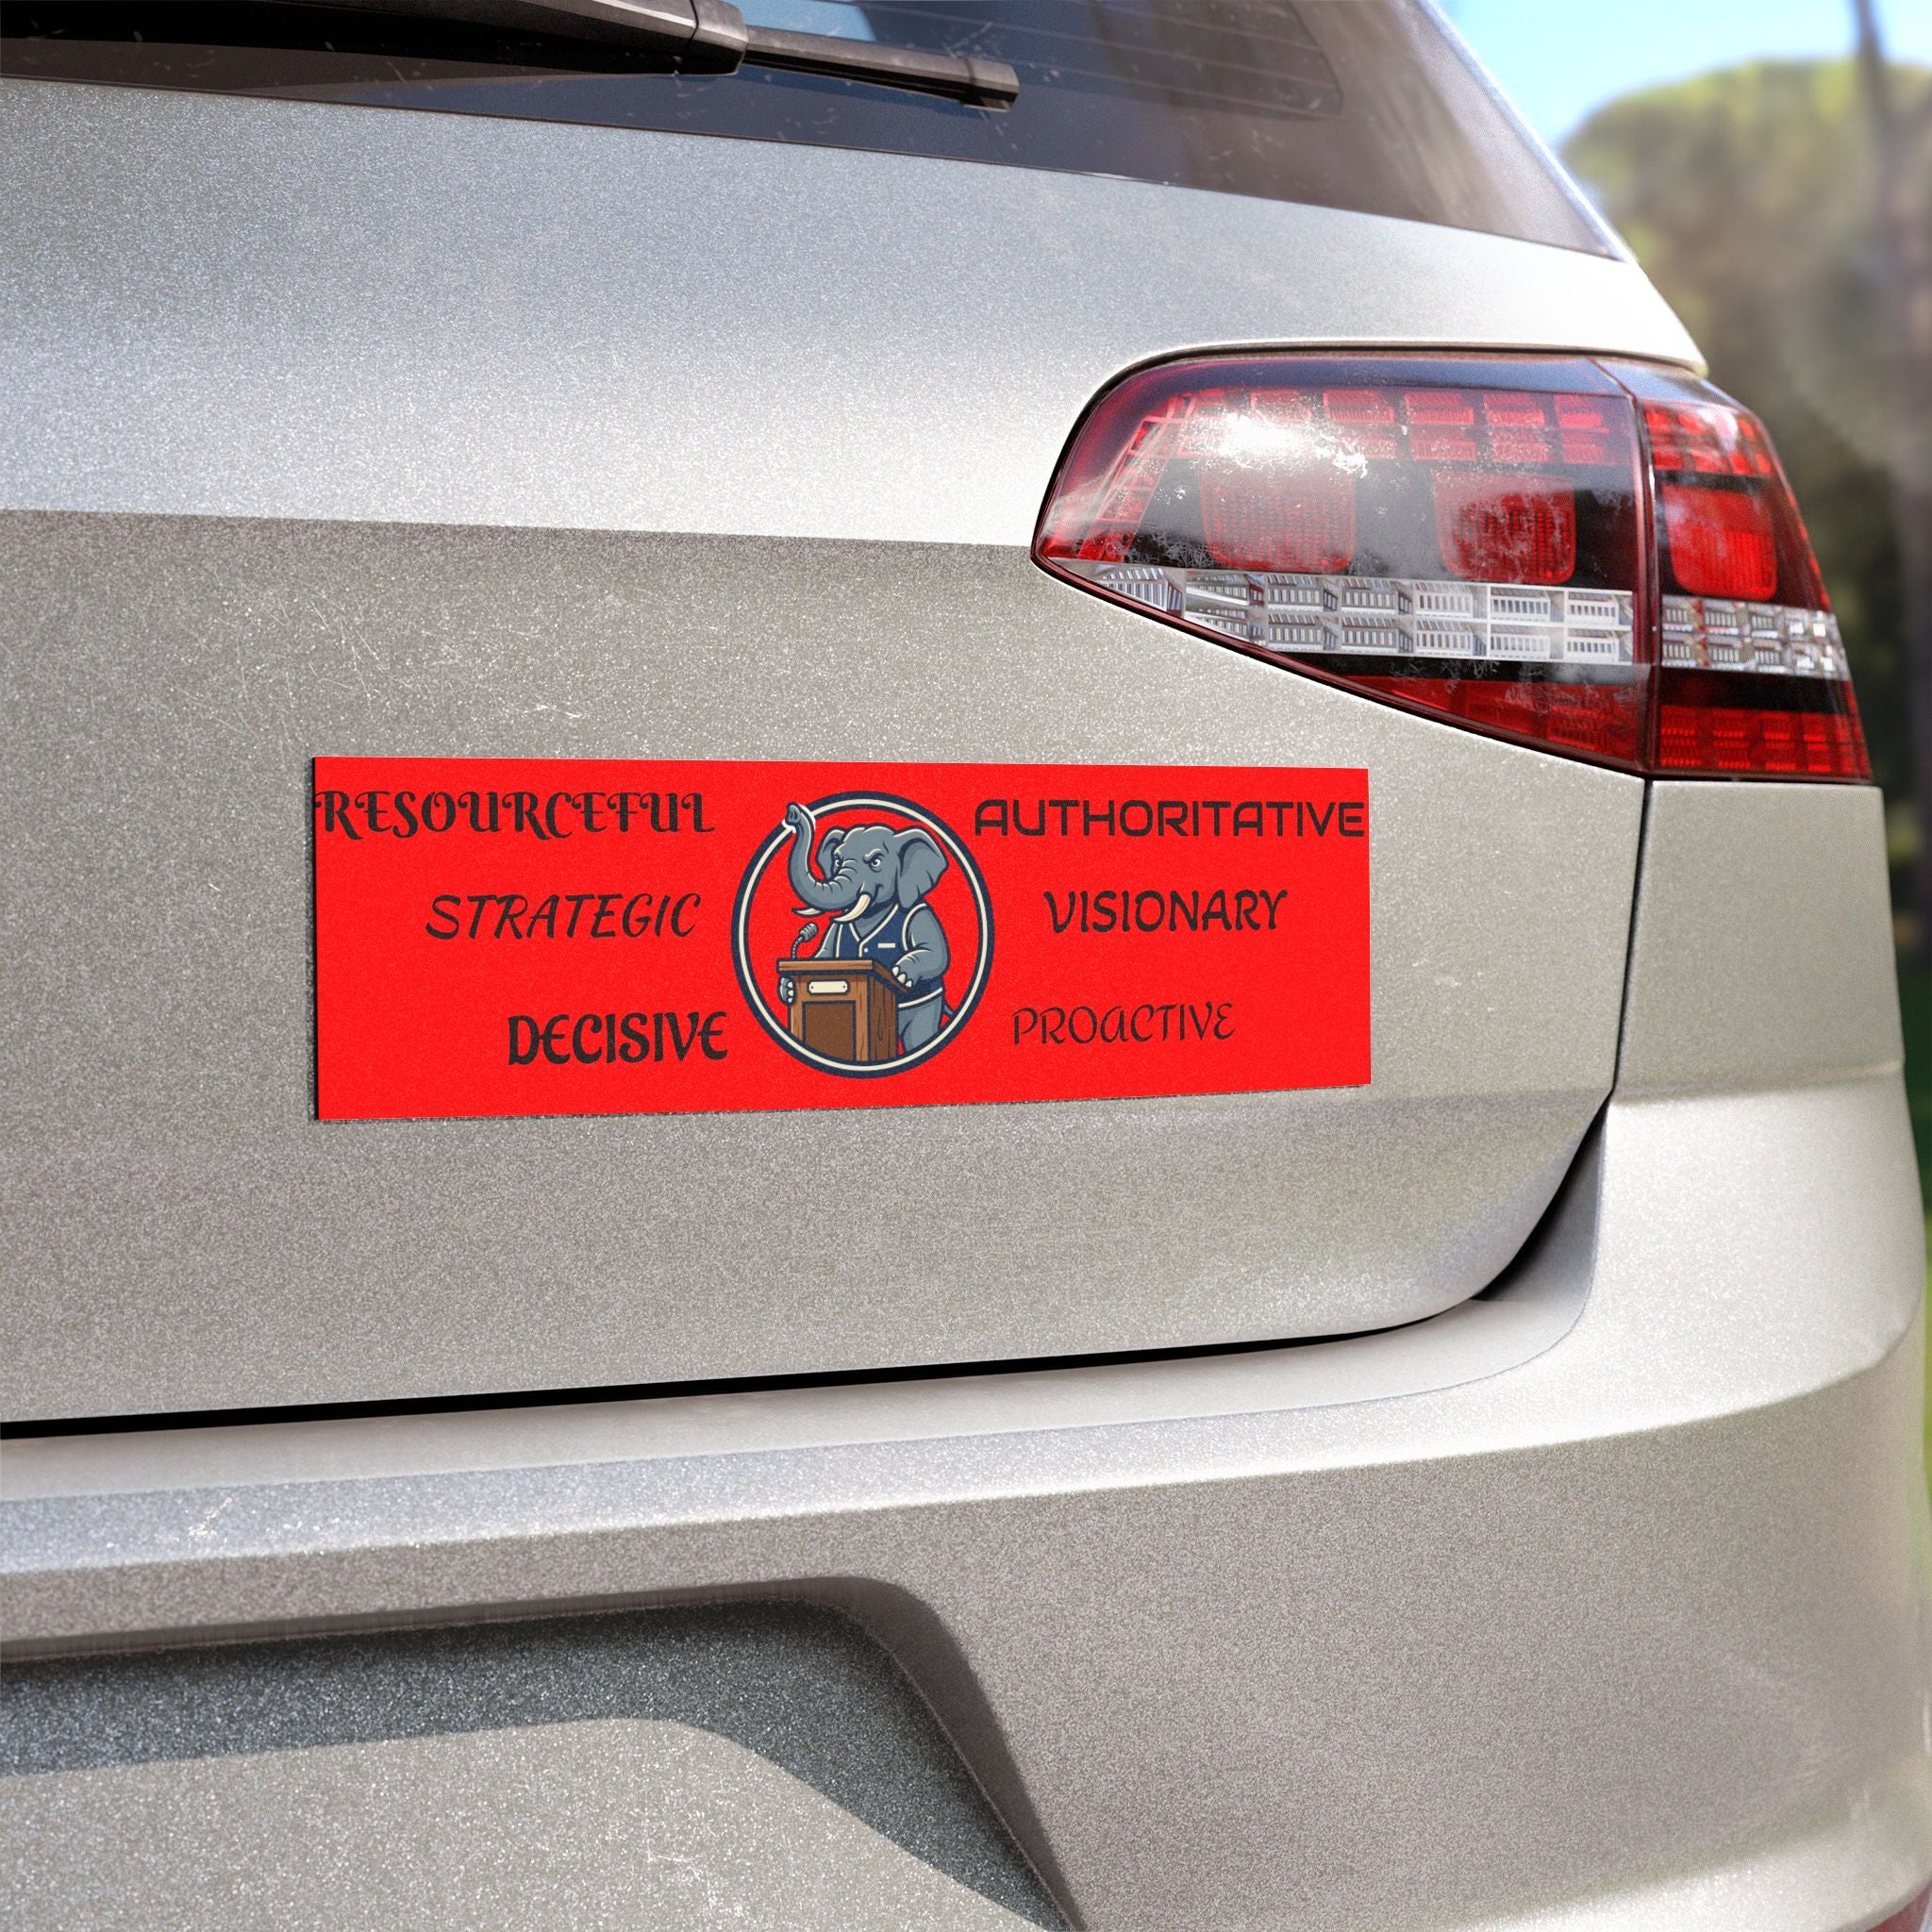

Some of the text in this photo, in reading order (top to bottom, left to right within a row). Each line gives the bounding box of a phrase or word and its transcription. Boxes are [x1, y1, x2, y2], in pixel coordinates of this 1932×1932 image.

[316, 791, 714, 841] RESOURCEFUL
[974, 799, 1365, 838] AUTHORITATIVE
[426, 893, 701, 941] STRATEGIC
[1043, 889, 1288, 933] VISIONARY
[508, 1010, 727, 1065] DECISIVE
[1012, 1002, 1235, 1045] PROACTIVE
